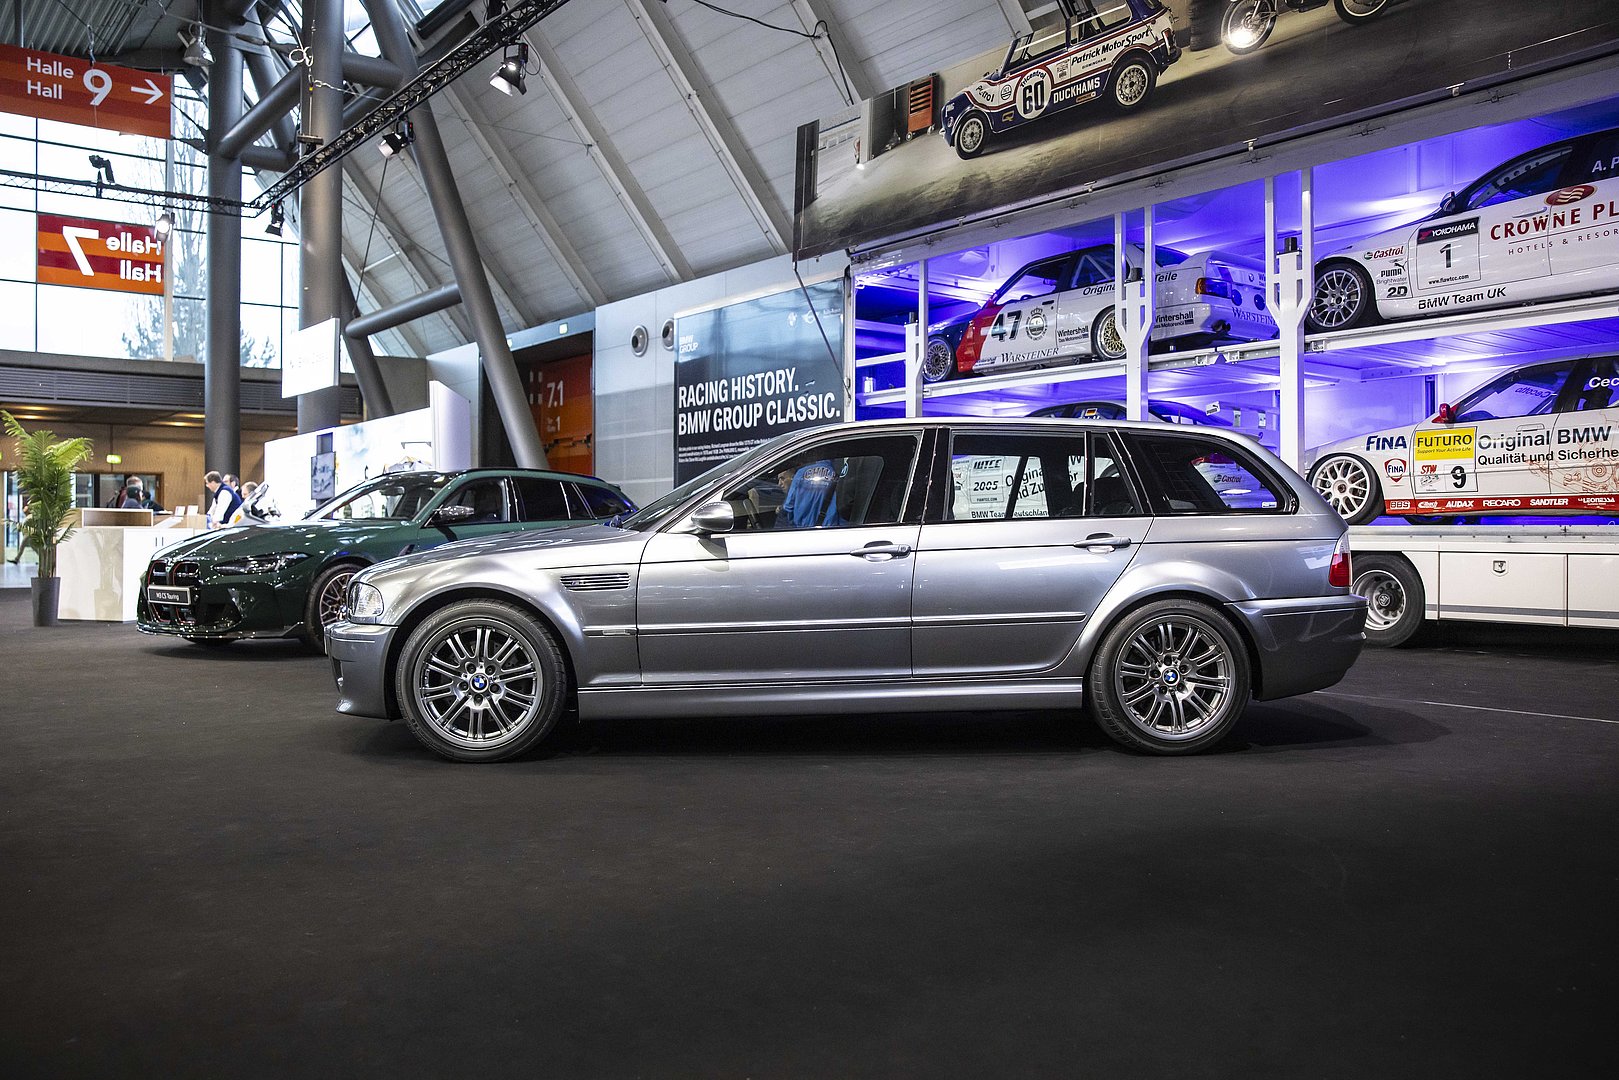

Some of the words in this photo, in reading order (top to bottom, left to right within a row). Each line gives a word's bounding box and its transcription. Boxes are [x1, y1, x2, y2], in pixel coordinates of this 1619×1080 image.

[1071, 48, 1101, 66] Patrick
[27, 57, 74, 79] Halle
[1020, 70, 1047, 88] Tricentrol
[27, 80, 63, 99] Hall
[83, 69, 113, 106] 9
[1053, 76, 1101, 104] DUCKHAMS
[1022, 80, 1045, 115] 60
[1591, 160, 1607, 173] A.
[1610, 156, 1619, 169] P
[1490, 208, 1581, 241] CROWNE
[1593, 201, 1619, 221] PL
[1432, 222, 1476, 237] YOKOHAMA
[1508, 242, 1553, 255] HOTELS
[1578, 228, 1619, 242] RESOR
[1373, 246, 1404, 259] Castrol
[1440, 243, 1452, 269] 1
[1380, 268, 1402, 278] PUMA
[1082, 282, 1115, 296] Origina
[1387, 285, 1408, 298] 2D
[1418, 295, 1450, 310] BMW
[1452, 292, 1484, 305] Team
[1486, 286, 1507, 299] UK
[990, 310, 1022, 342] 47
[1057, 325, 1089, 338] Wintershall
[679, 342, 699, 354] GROUP
[1001, 347, 1060, 363] WARSTEINER
[678, 378, 728, 409] RACING
[731, 367, 799, 401] HISTORY.
[1588, 376, 1619, 389] Cec
[546, 380, 564, 408] 7.1
[678, 409, 711, 436] BMW
[713, 402, 763, 432] GROUP
[766, 392, 841, 426] CLASSIC.
[1366, 435, 1408, 451] FINA
[1417, 434, 1473, 448] FUTURO
[1478, 430, 1550, 452] Original
[1557, 425, 1612, 444] BMW
[1478, 452, 1526, 465] Qualität
[1530, 451, 1554, 462] und
[1558, 447, 1619, 461] Sicherhe
[1387, 464, 1404, 474] FINA
[1420, 464, 1438, 475] STW
[1451, 465, 1467, 488] 9
[973, 480, 999, 491] 2005
[1221, 475, 1242, 483] Castrol
[1445, 500, 1475, 508] AUDAX
[1483, 499, 1521, 507] RECARO
[1529, 498, 1569, 506] SANDTLER
[971, 511, 988, 519] BMW
[1013, 509, 1048, 517] eutschlan
